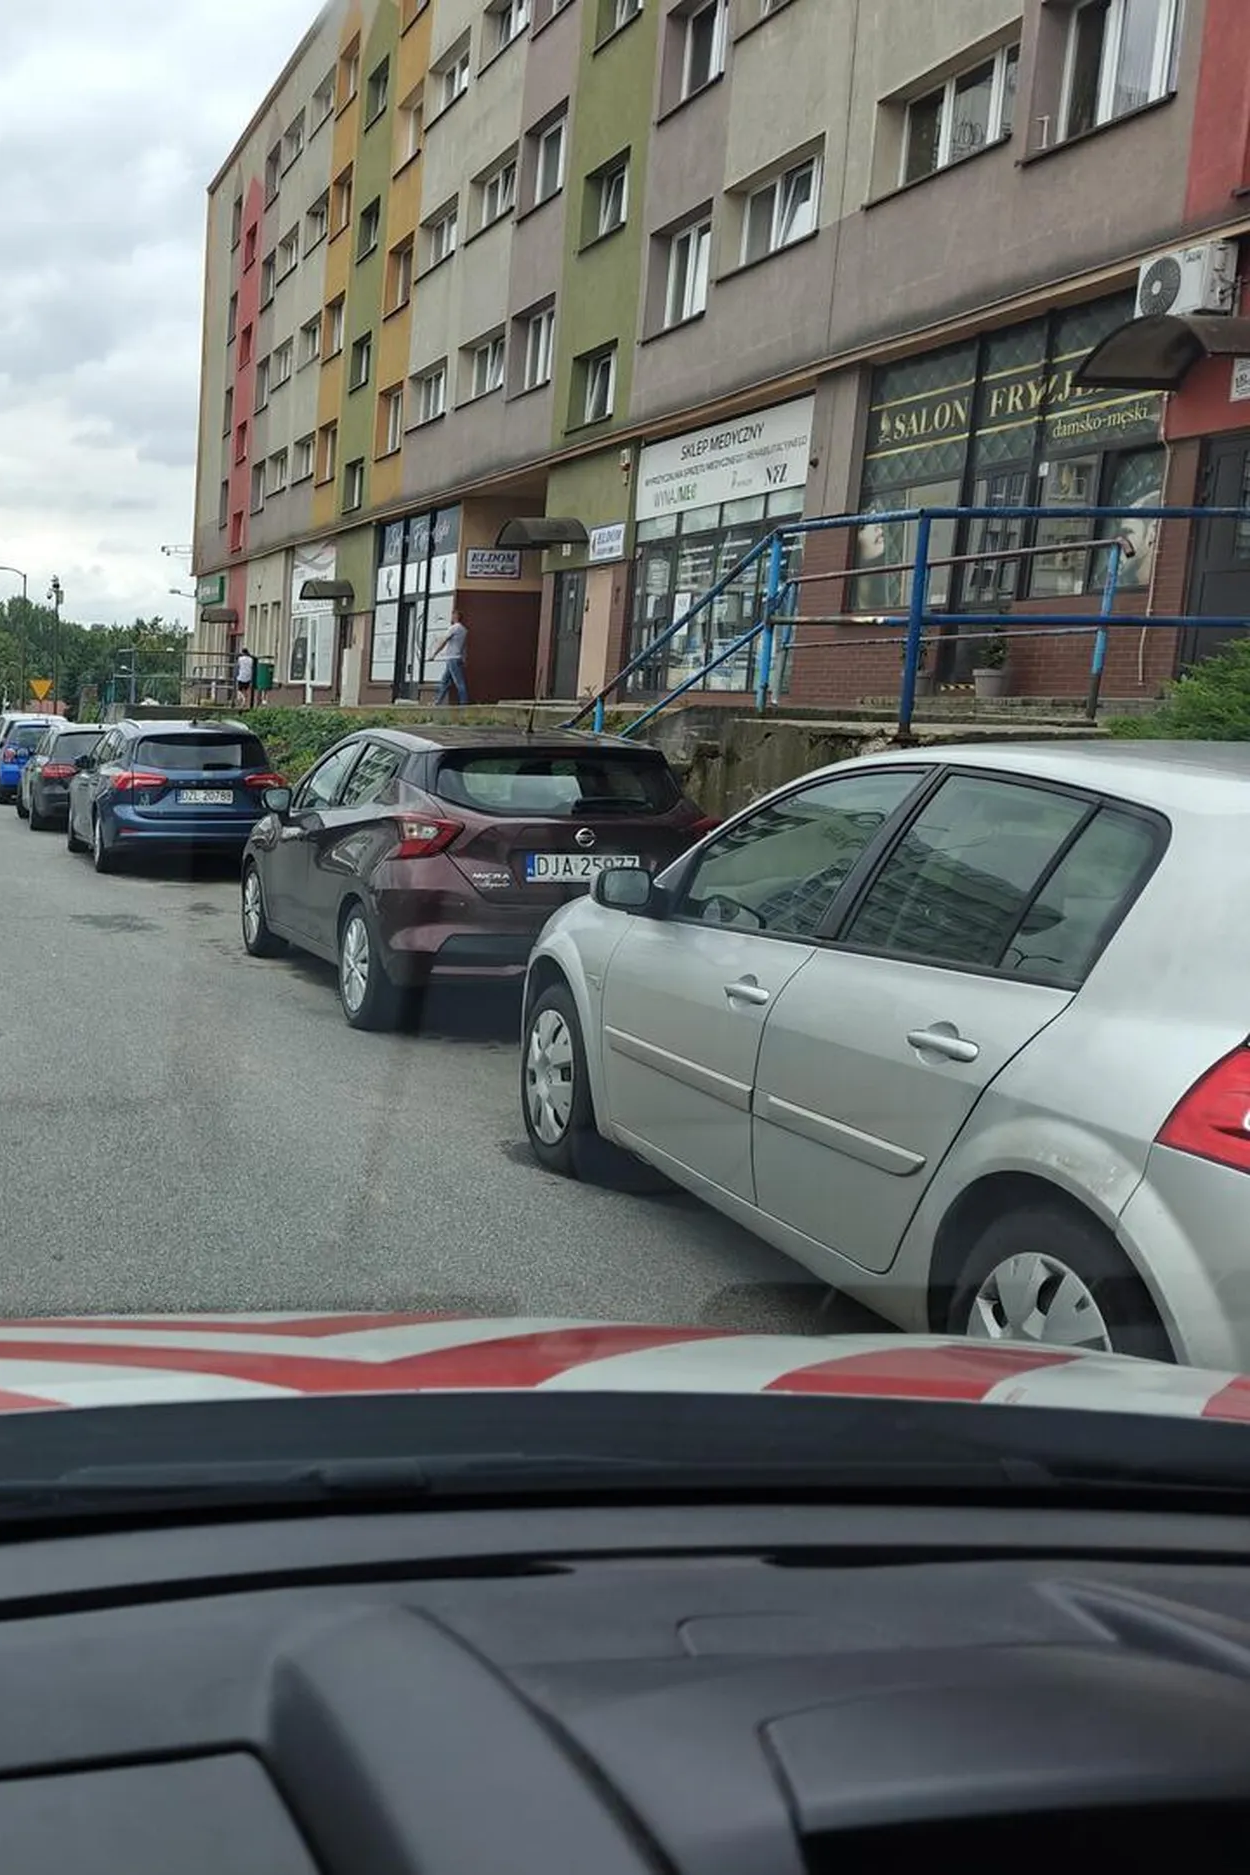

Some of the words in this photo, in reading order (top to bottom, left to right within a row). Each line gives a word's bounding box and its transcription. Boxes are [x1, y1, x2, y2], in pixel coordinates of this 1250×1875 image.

[893, 396, 970, 440] SALON
[1052, 402, 1148, 439] damsko-męski
[680, 438, 709, 461] SKLEP
[710, 421, 765, 450] MEDYCZNY
[764, 463, 788, 486] NFZ
[471, 552, 516, 562] ELDOM
[472, 872, 510, 880] MICRA
[537, 857, 573, 876] DJA
